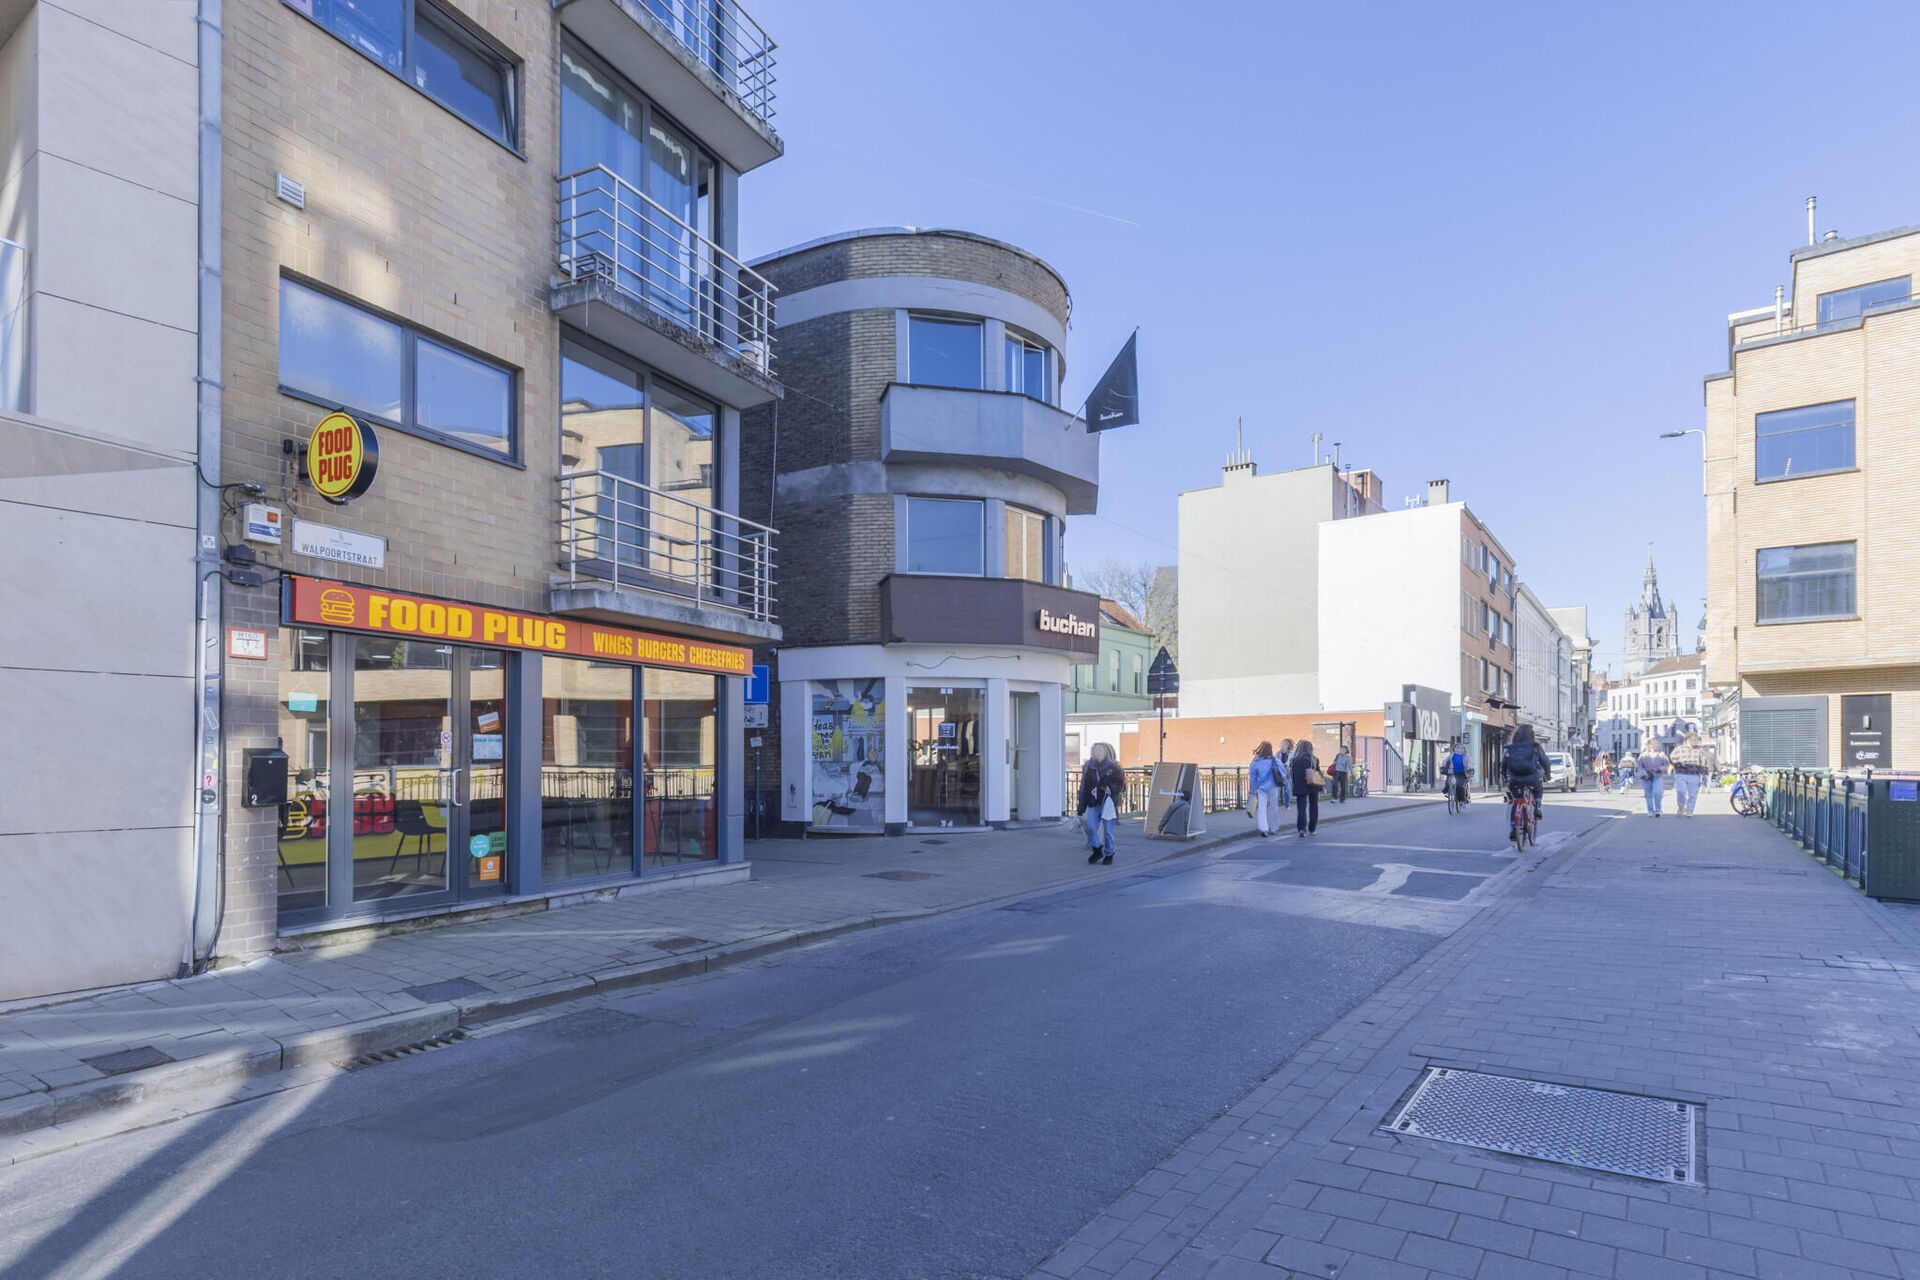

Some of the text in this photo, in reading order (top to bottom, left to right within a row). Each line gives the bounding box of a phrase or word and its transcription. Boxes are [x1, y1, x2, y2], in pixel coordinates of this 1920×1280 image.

[318, 426, 353, 457] FOOD
[318, 454, 353, 484] PLUG
[301, 543, 378, 566] WALPOORTSTRAAT
[369, 594, 566, 650] FOOD PLUG
[1040, 608, 1096, 638] buchan
[593, 631, 745, 670] WINGS BURGERS CHEESEFRIES
[1417, 708, 1440, 741] Y&D
[251, 794, 258, 805] 2
